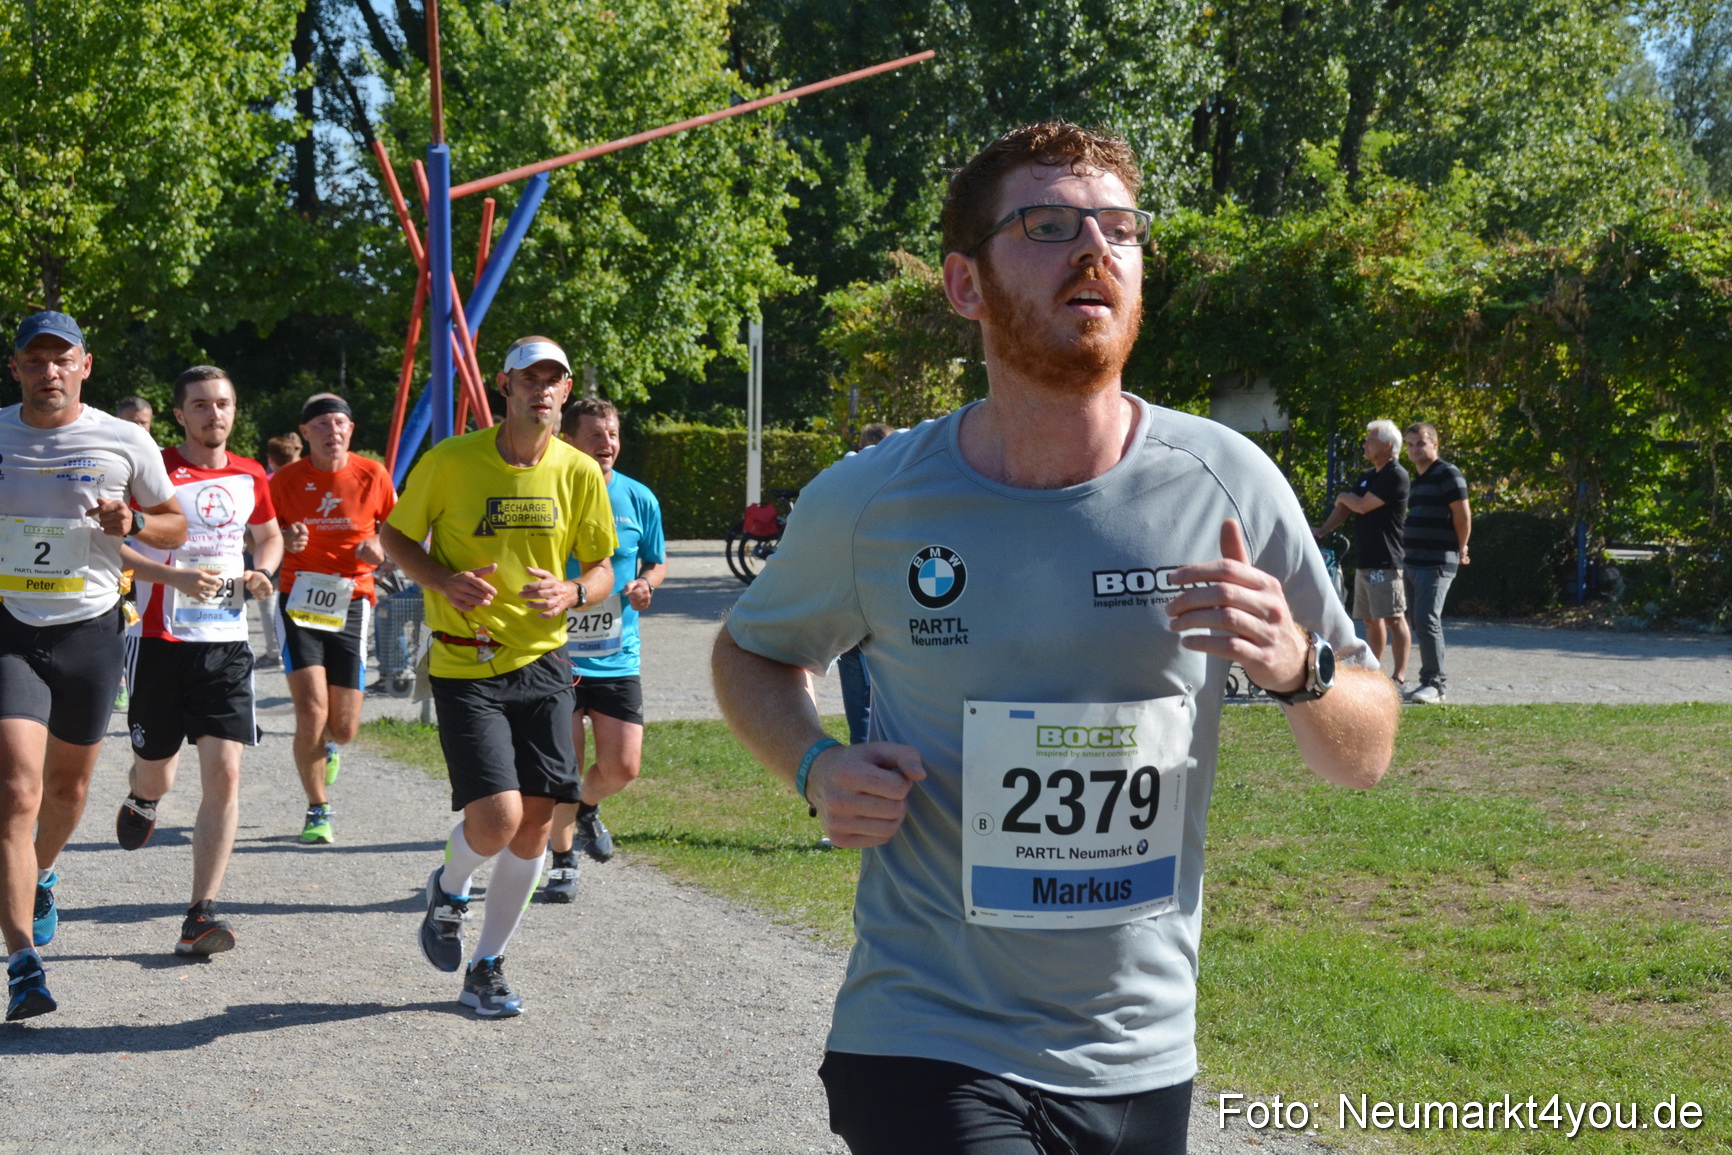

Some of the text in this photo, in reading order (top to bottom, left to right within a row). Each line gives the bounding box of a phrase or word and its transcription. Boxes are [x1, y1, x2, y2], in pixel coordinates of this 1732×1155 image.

[497, 503, 547, 513] RECHARGE
[491, 513, 552, 523] ENDORPHINS
[24, 525, 65, 536] BOCK
[33, 541, 51, 565] 2
[913, 547, 961, 568] BMW
[26, 579, 56, 590] Peter
[306, 587, 337, 608] 100
[1094, 598, 1134, 608] inspired
[1136, 596, 1148, 606] by
[196, 611, 224, 620] Jonas
[566, 612, 613, 633] 2479
[909, 617, 969, 634] PARTL
[911, 633, 969, 646] Neumarkt
[578, 643, 601, 651] Claus
[1037, 725, 1138, 749] BOCK
[1036, 749, 1139, 758] inspired by smart concepts
[1001, 765, 1161, 836] 2379
[979, 818, 987, 830] B
[1016, 844, 1133, 860] PARTL Neumarkt
[1032, 876, 1132, 905] Markus
